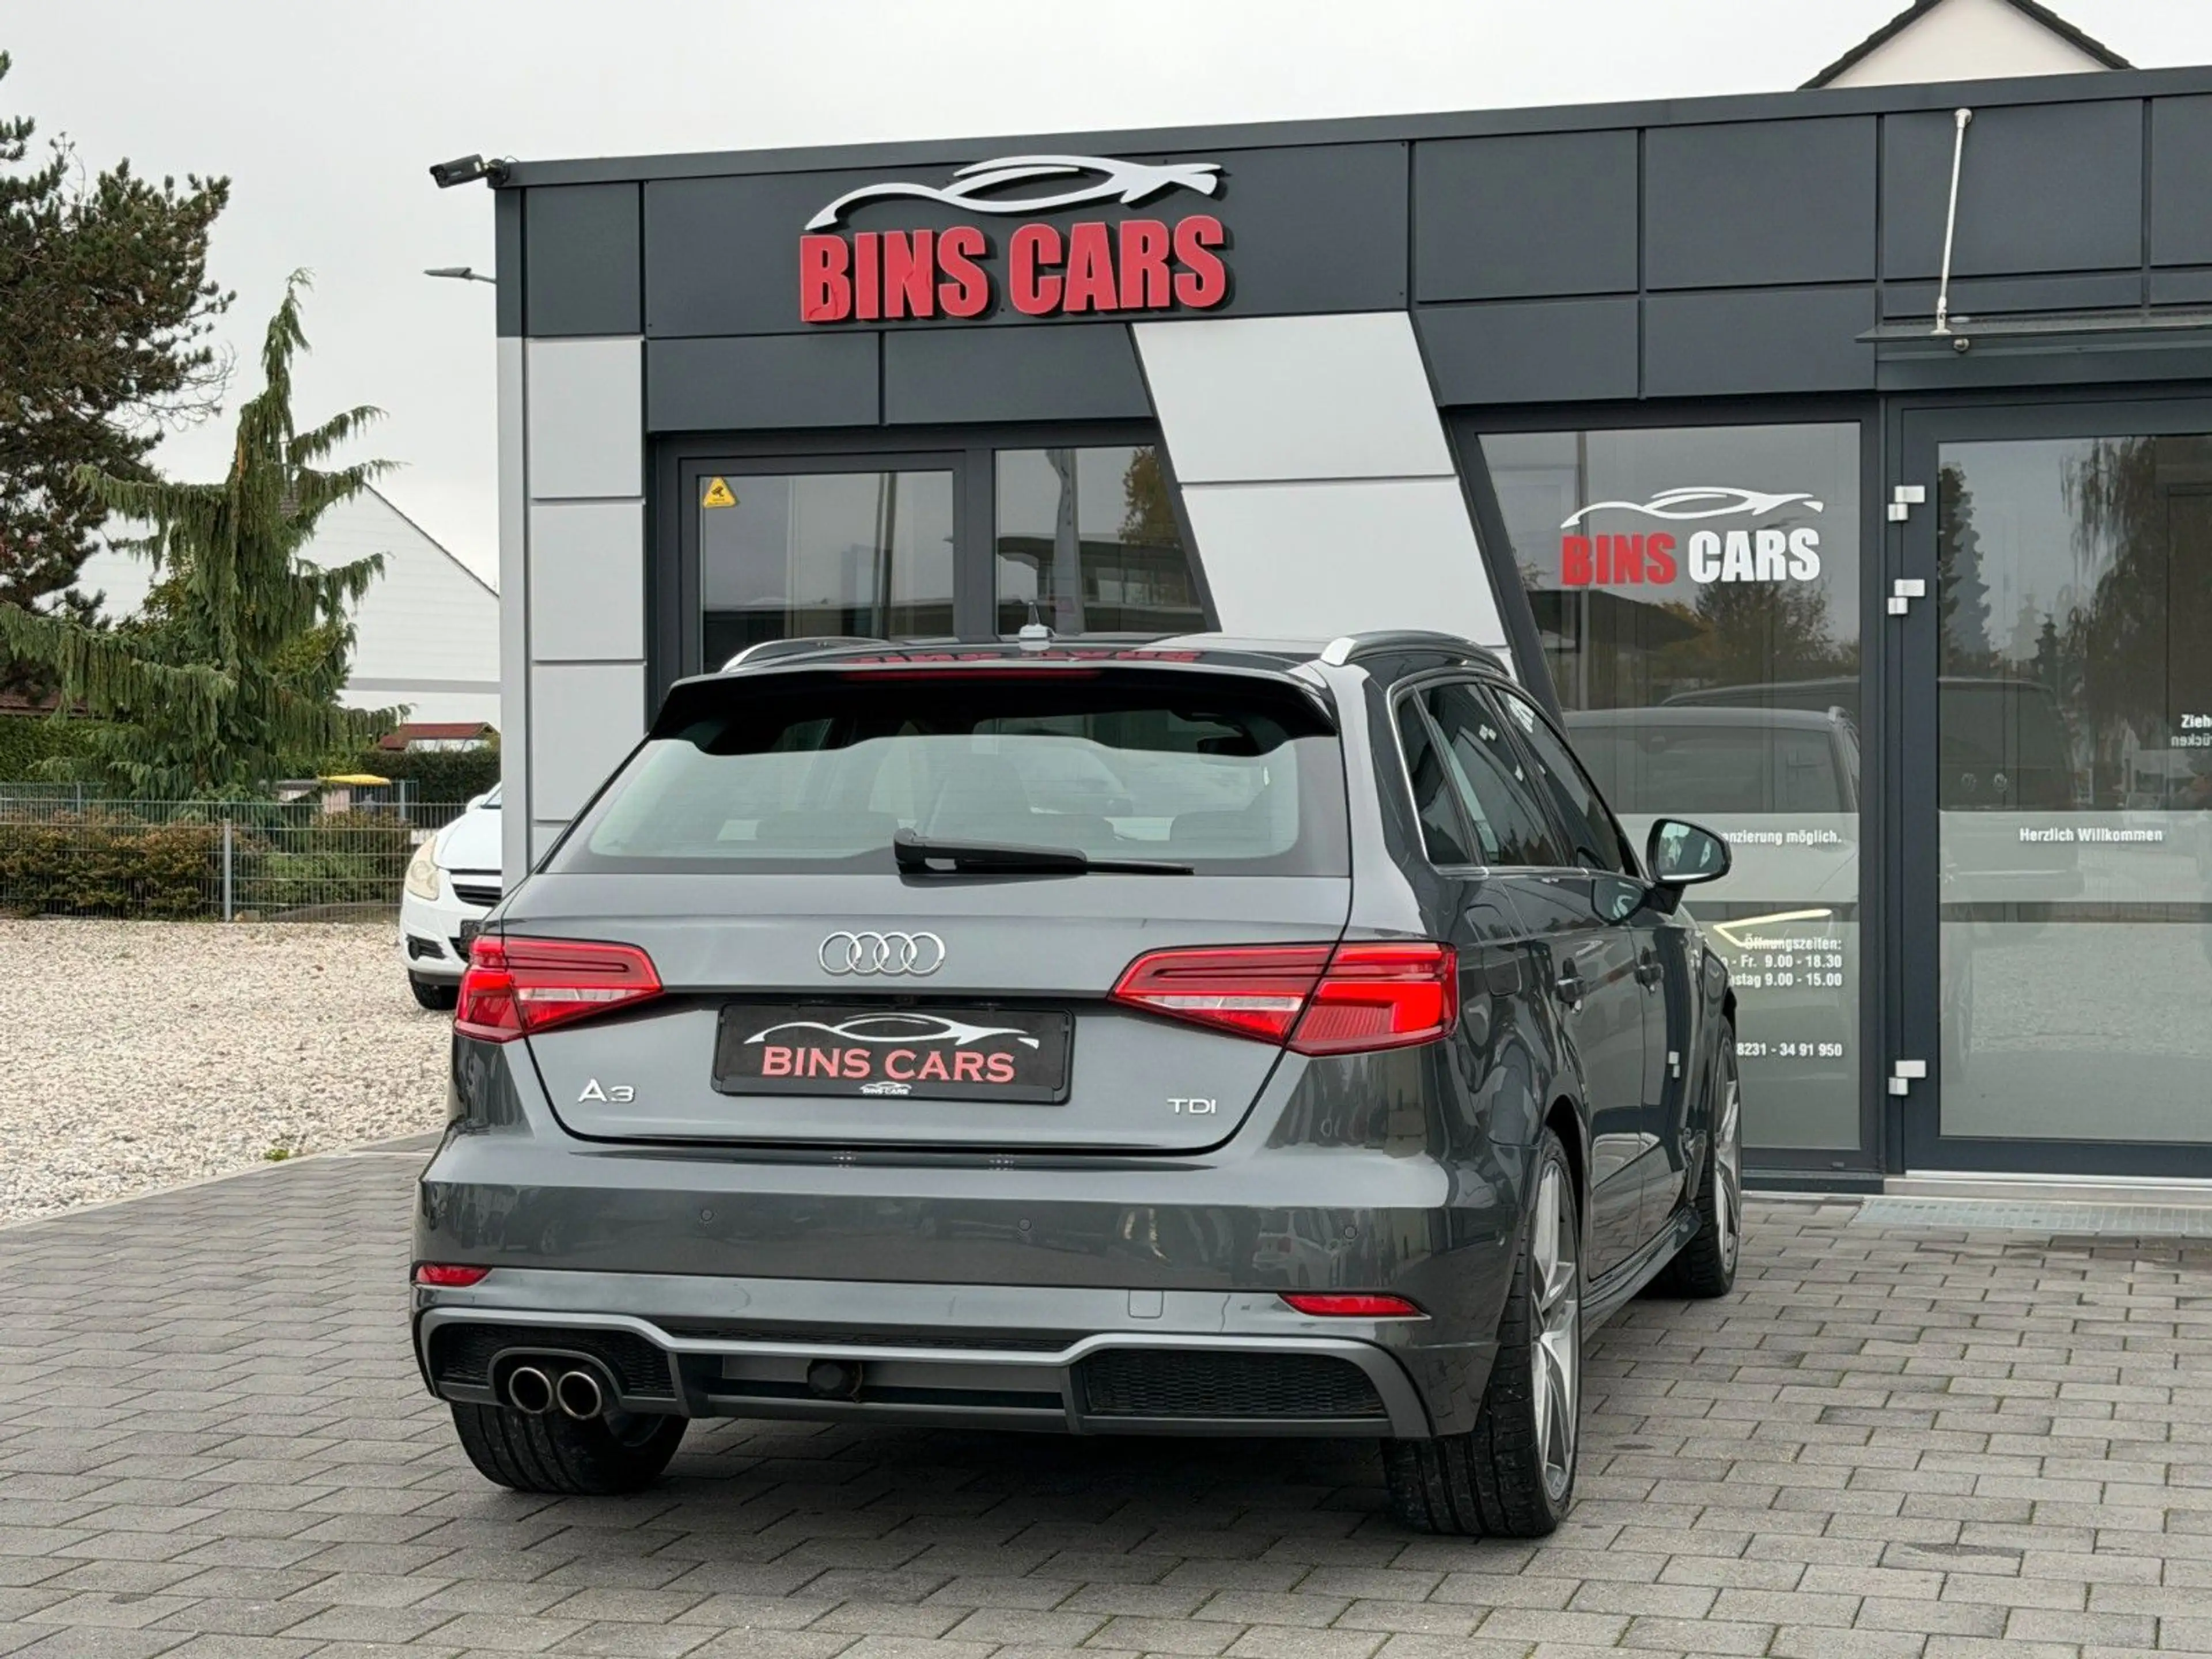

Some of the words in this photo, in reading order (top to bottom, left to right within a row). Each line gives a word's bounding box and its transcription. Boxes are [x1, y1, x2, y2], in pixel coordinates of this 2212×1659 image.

[800, 226, 988, 323] BINS
[1009, 215, 1226, 315] CARS
[1560, 532, 1677, 586] BINS
[1688, 527, 1821, 583] CARS
[2180, 714, 2212, 729] Zieh
[1786, 830, 1842, 846] möglich.
[2019, 827, 2074, 842] Herzlich
[2077, 827, 2163, 842] Willkommen
[1740, 954, 1757, 968] Fr.
[1764, 954, 1793, 968] 9.00
[1805, 954, 1842, 968] 18.30
[1764, 972, 1793, 986] 9.00
[1805, 972, 1842, 986] 15.00
[1779, 1042, 1796, 1056] 34
[1798, 1043, 1814, 1056] 91
[1818, 1043, 1843, 1056] 950
[761, 1046, 872, 1080] BINS
[884, 1049, 1016, 1083] CARS
[578, 1078, 635, 1103] A3
[1166, 1098, 1217, 1113] TDI
